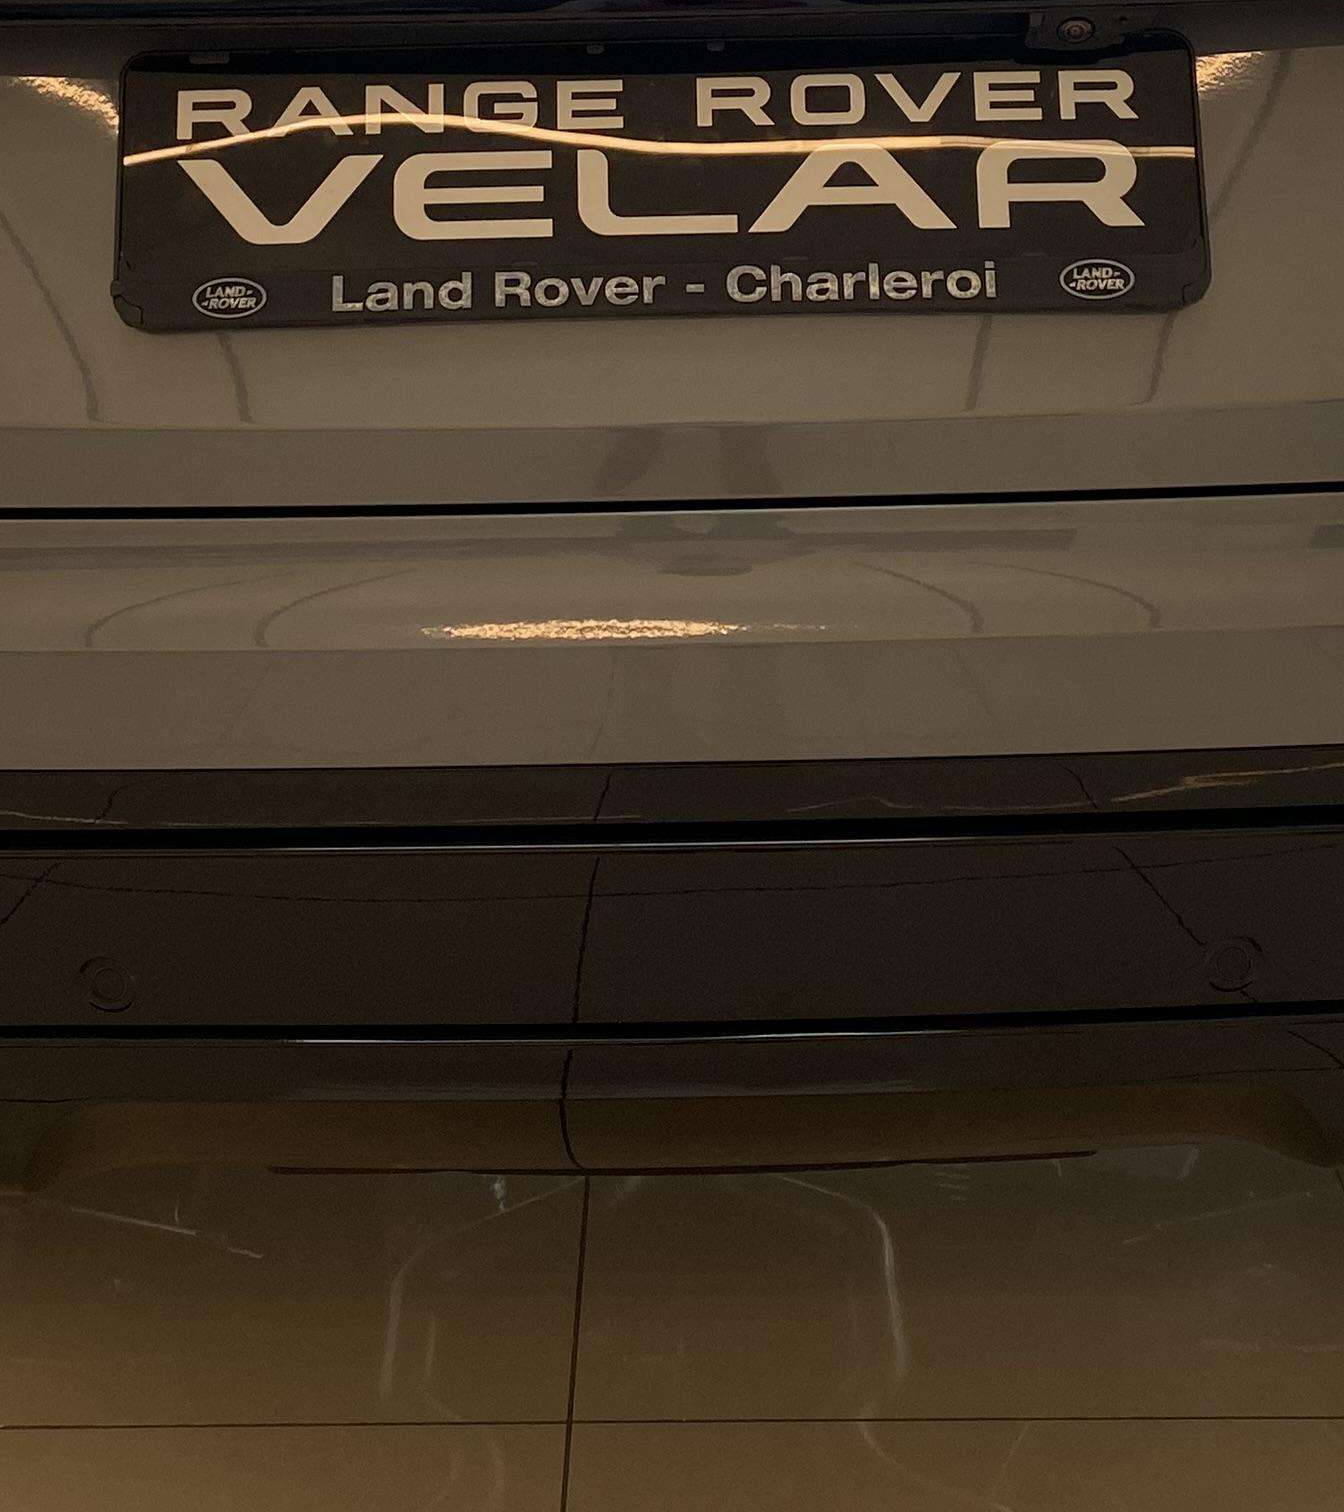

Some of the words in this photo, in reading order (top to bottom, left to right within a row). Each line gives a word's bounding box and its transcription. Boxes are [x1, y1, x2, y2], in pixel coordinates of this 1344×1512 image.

[176, 78, 625, 140] RANGE
[696, 69, 1139, 127] ROVER
[177, 141, 1146, 245] VELAR
[1072, 267, 1113, 279] LAND
[331, 271, 472, 313] Land
[494, 270, 666, 309] Rover
[725, 260, 998, 304] Charleroi
[1076, 278, 1126, 290] ROVER
[205, 286, 247, 298] LAND
[207, 297, 257, 309] ROVER
